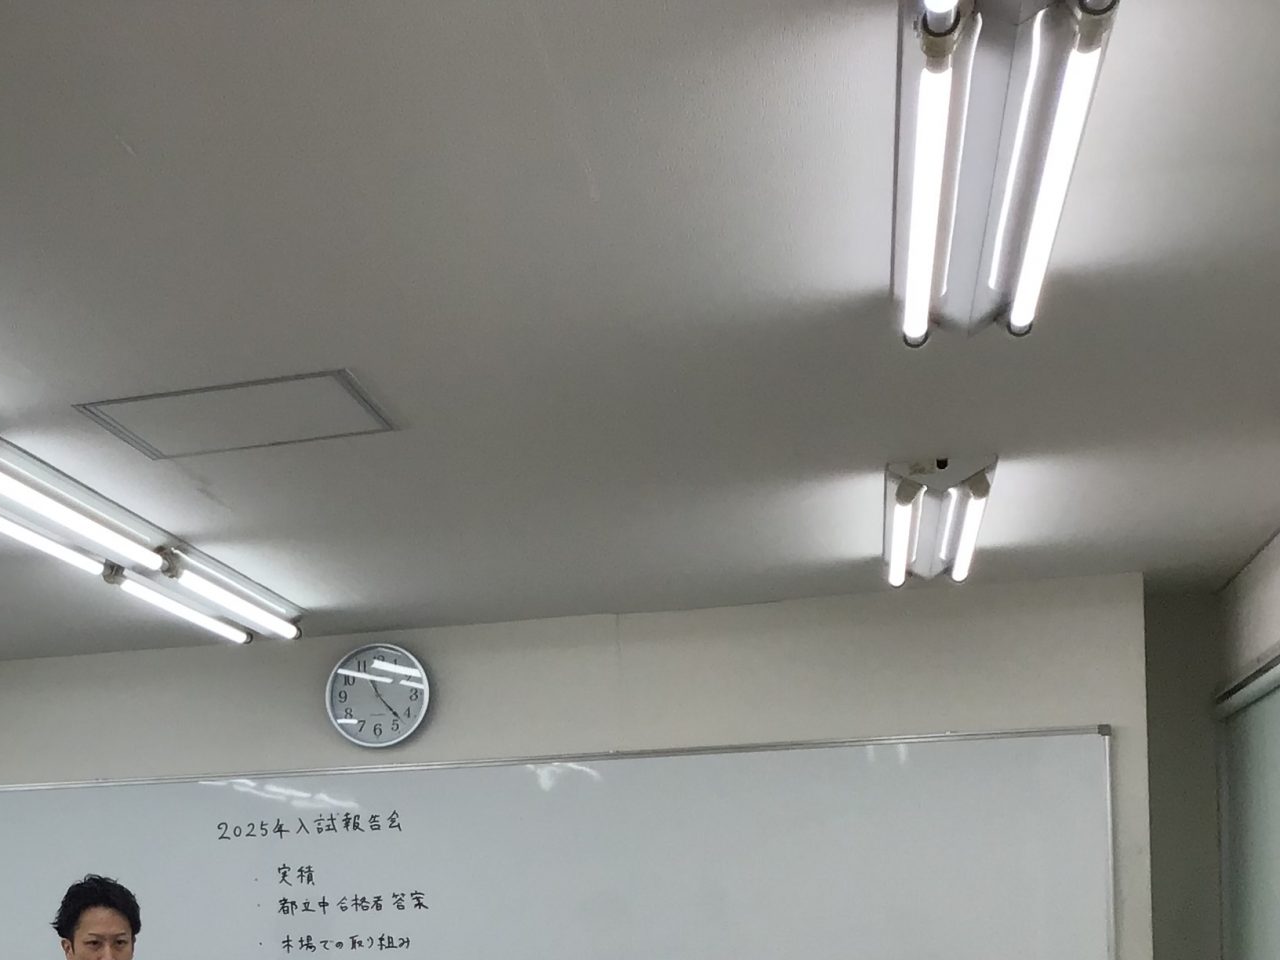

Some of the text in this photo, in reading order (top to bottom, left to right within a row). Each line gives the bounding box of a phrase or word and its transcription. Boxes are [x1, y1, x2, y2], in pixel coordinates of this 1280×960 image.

[357, 660, 367, 673] 11
[343, 676, 356, 686] 10
[338, 690, 348, 703] 9
[409, 688, 419, 701] 3
[344, 708, 353, 720] 8
[404, 706, 411, 718] 4
[357, 720, 366, 733] 7
[373, 723, 382, 736] 6
[391, 719, 400, 732] 5
[217, 810, 402, 840] 2025年入試報告会
[278, 890, 429, 916] 都立中合格者答案
